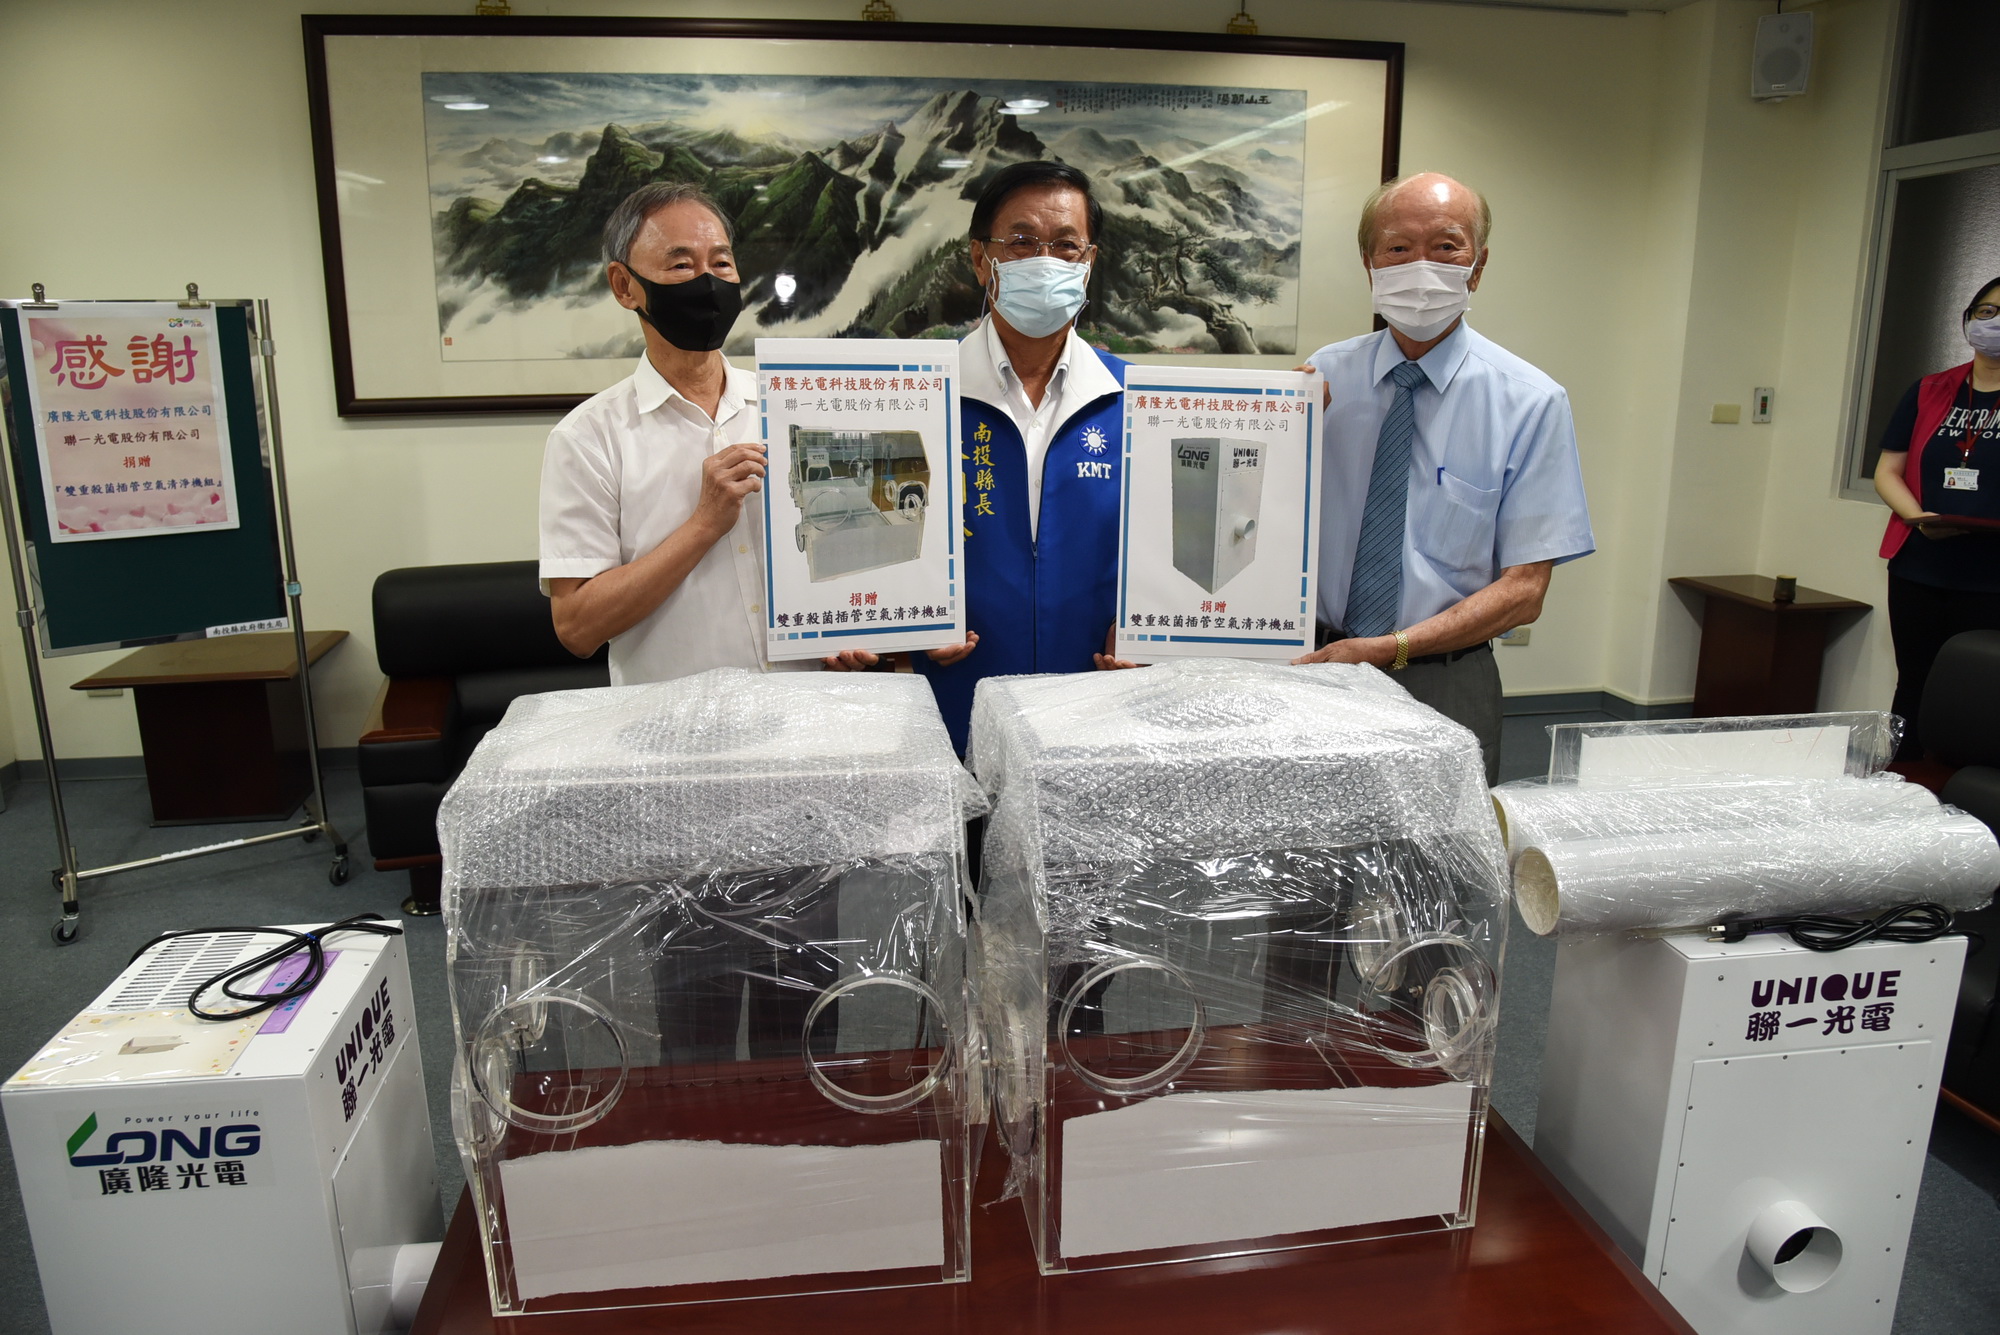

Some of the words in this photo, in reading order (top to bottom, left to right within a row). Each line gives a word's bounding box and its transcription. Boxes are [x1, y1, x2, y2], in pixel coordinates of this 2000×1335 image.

[50, 333, 199, 390] 感謝
[768, 376, 943, 392] 廣隆光電科技股份有限公司
[47, 404, 211, 424] 廣隆光電科技股份有限公司
[784, 397, 929, 412] 聯一光電股份有限公司
[1134, 396, 1306, 415] 廣隆光電科技股份有限公司
[1147, 415, 1289, 432] 聯一光電股份有限公司
[63, 428, 201, 447] 聯一光電股份有限公司
[122, 454, 151, 469] 捐贈
[1233, 447, 1259, 458] UNIQUE
[972, 421, 996, 517] 南投縣長
[1076, 461, 1112, 480] KMT
[849, 591, 878, 607] 捐贈
[1200, 600, 1227, 614] 捐贈
[776, 605, 949, 628] 雙重殺菌插管空氣清淨機組
[1130, 613, 1296, 632] 雙重殺菌插管空氣清淨機組
[1751, 970, 1901, 1008] UNIQUE
[335, 976, 391, 1085] UNIQUE
[1745, 1002, 1895, 1042] 聯一光電
[342, 1009, 395, 1123] 聯一光電
[124, 1116, 173, 1124] Power
[184, 1112, 220, 1122] your
[230, 1109, 259, 1118] life
[66, 1111, 261, 1167] LONG
[98, 1160, 248, 1195] 廣隆光電
